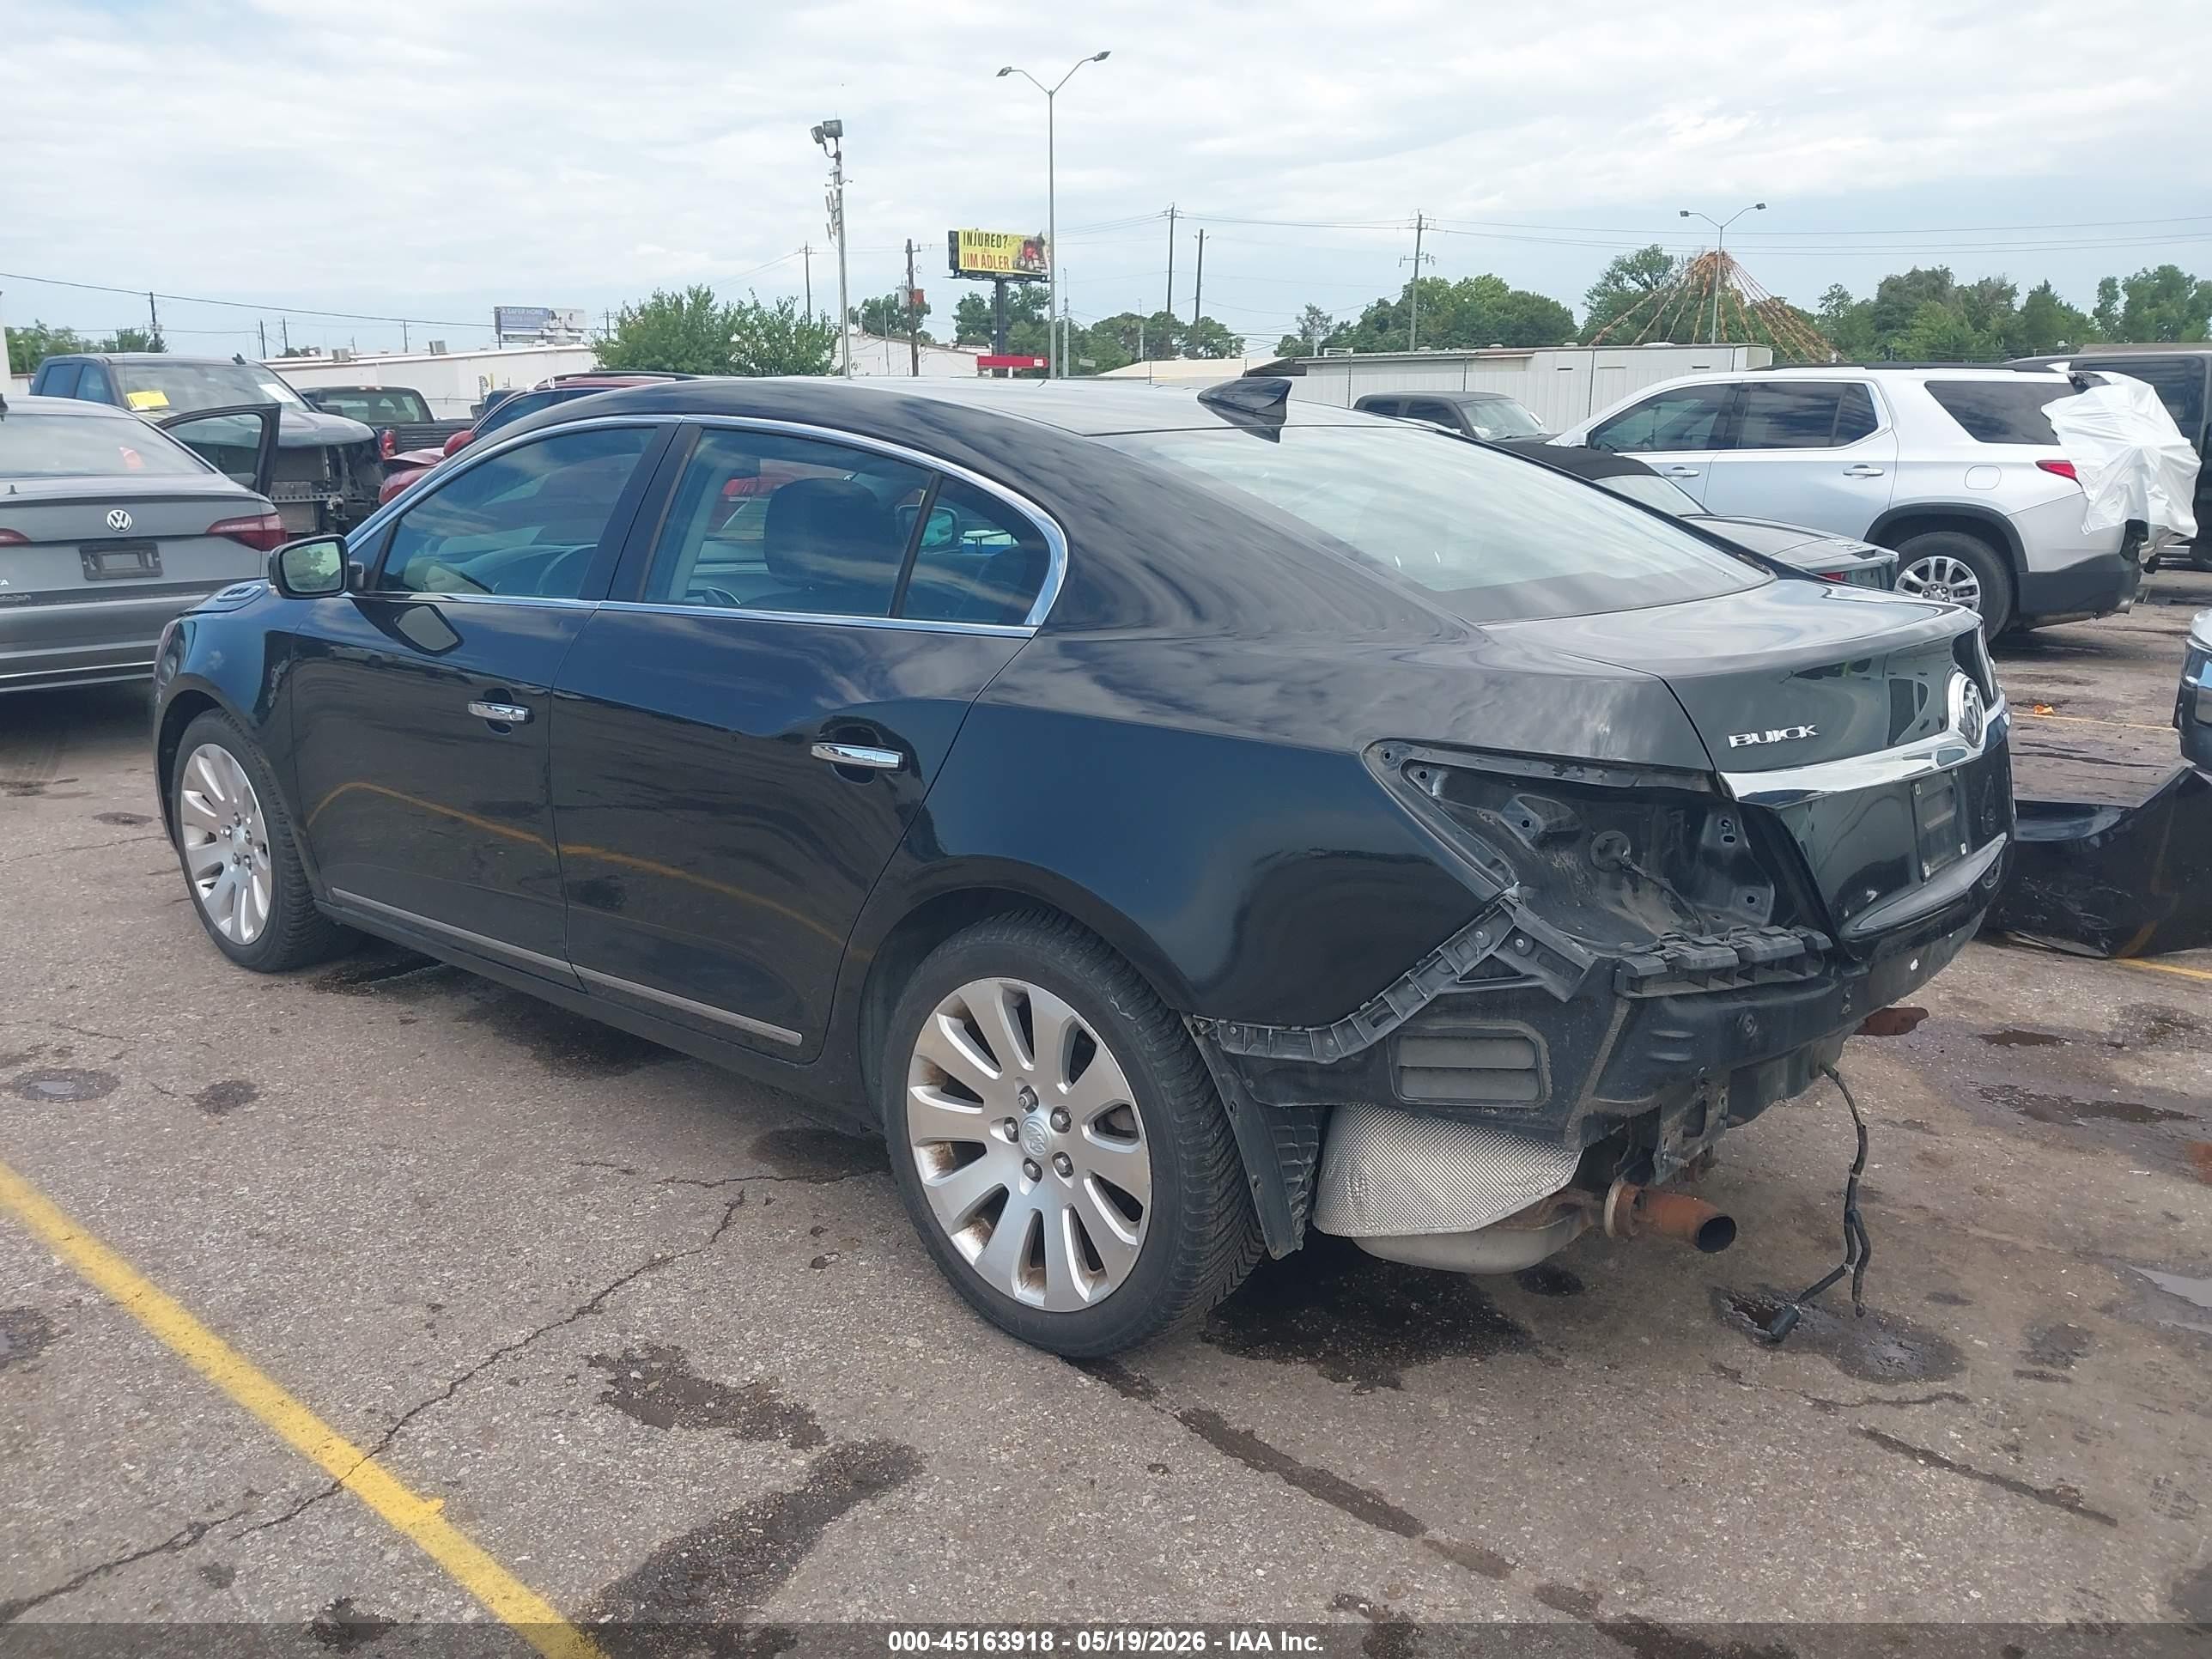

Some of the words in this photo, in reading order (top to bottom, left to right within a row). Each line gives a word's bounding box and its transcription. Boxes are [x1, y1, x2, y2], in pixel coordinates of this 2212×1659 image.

[963, 231, 1009, 249] INJURED?
[963, 252, 979, 269] JIM
[981, 253, 1010, 270] ADLER
[1728, 724, 1820, 749] BUICK
